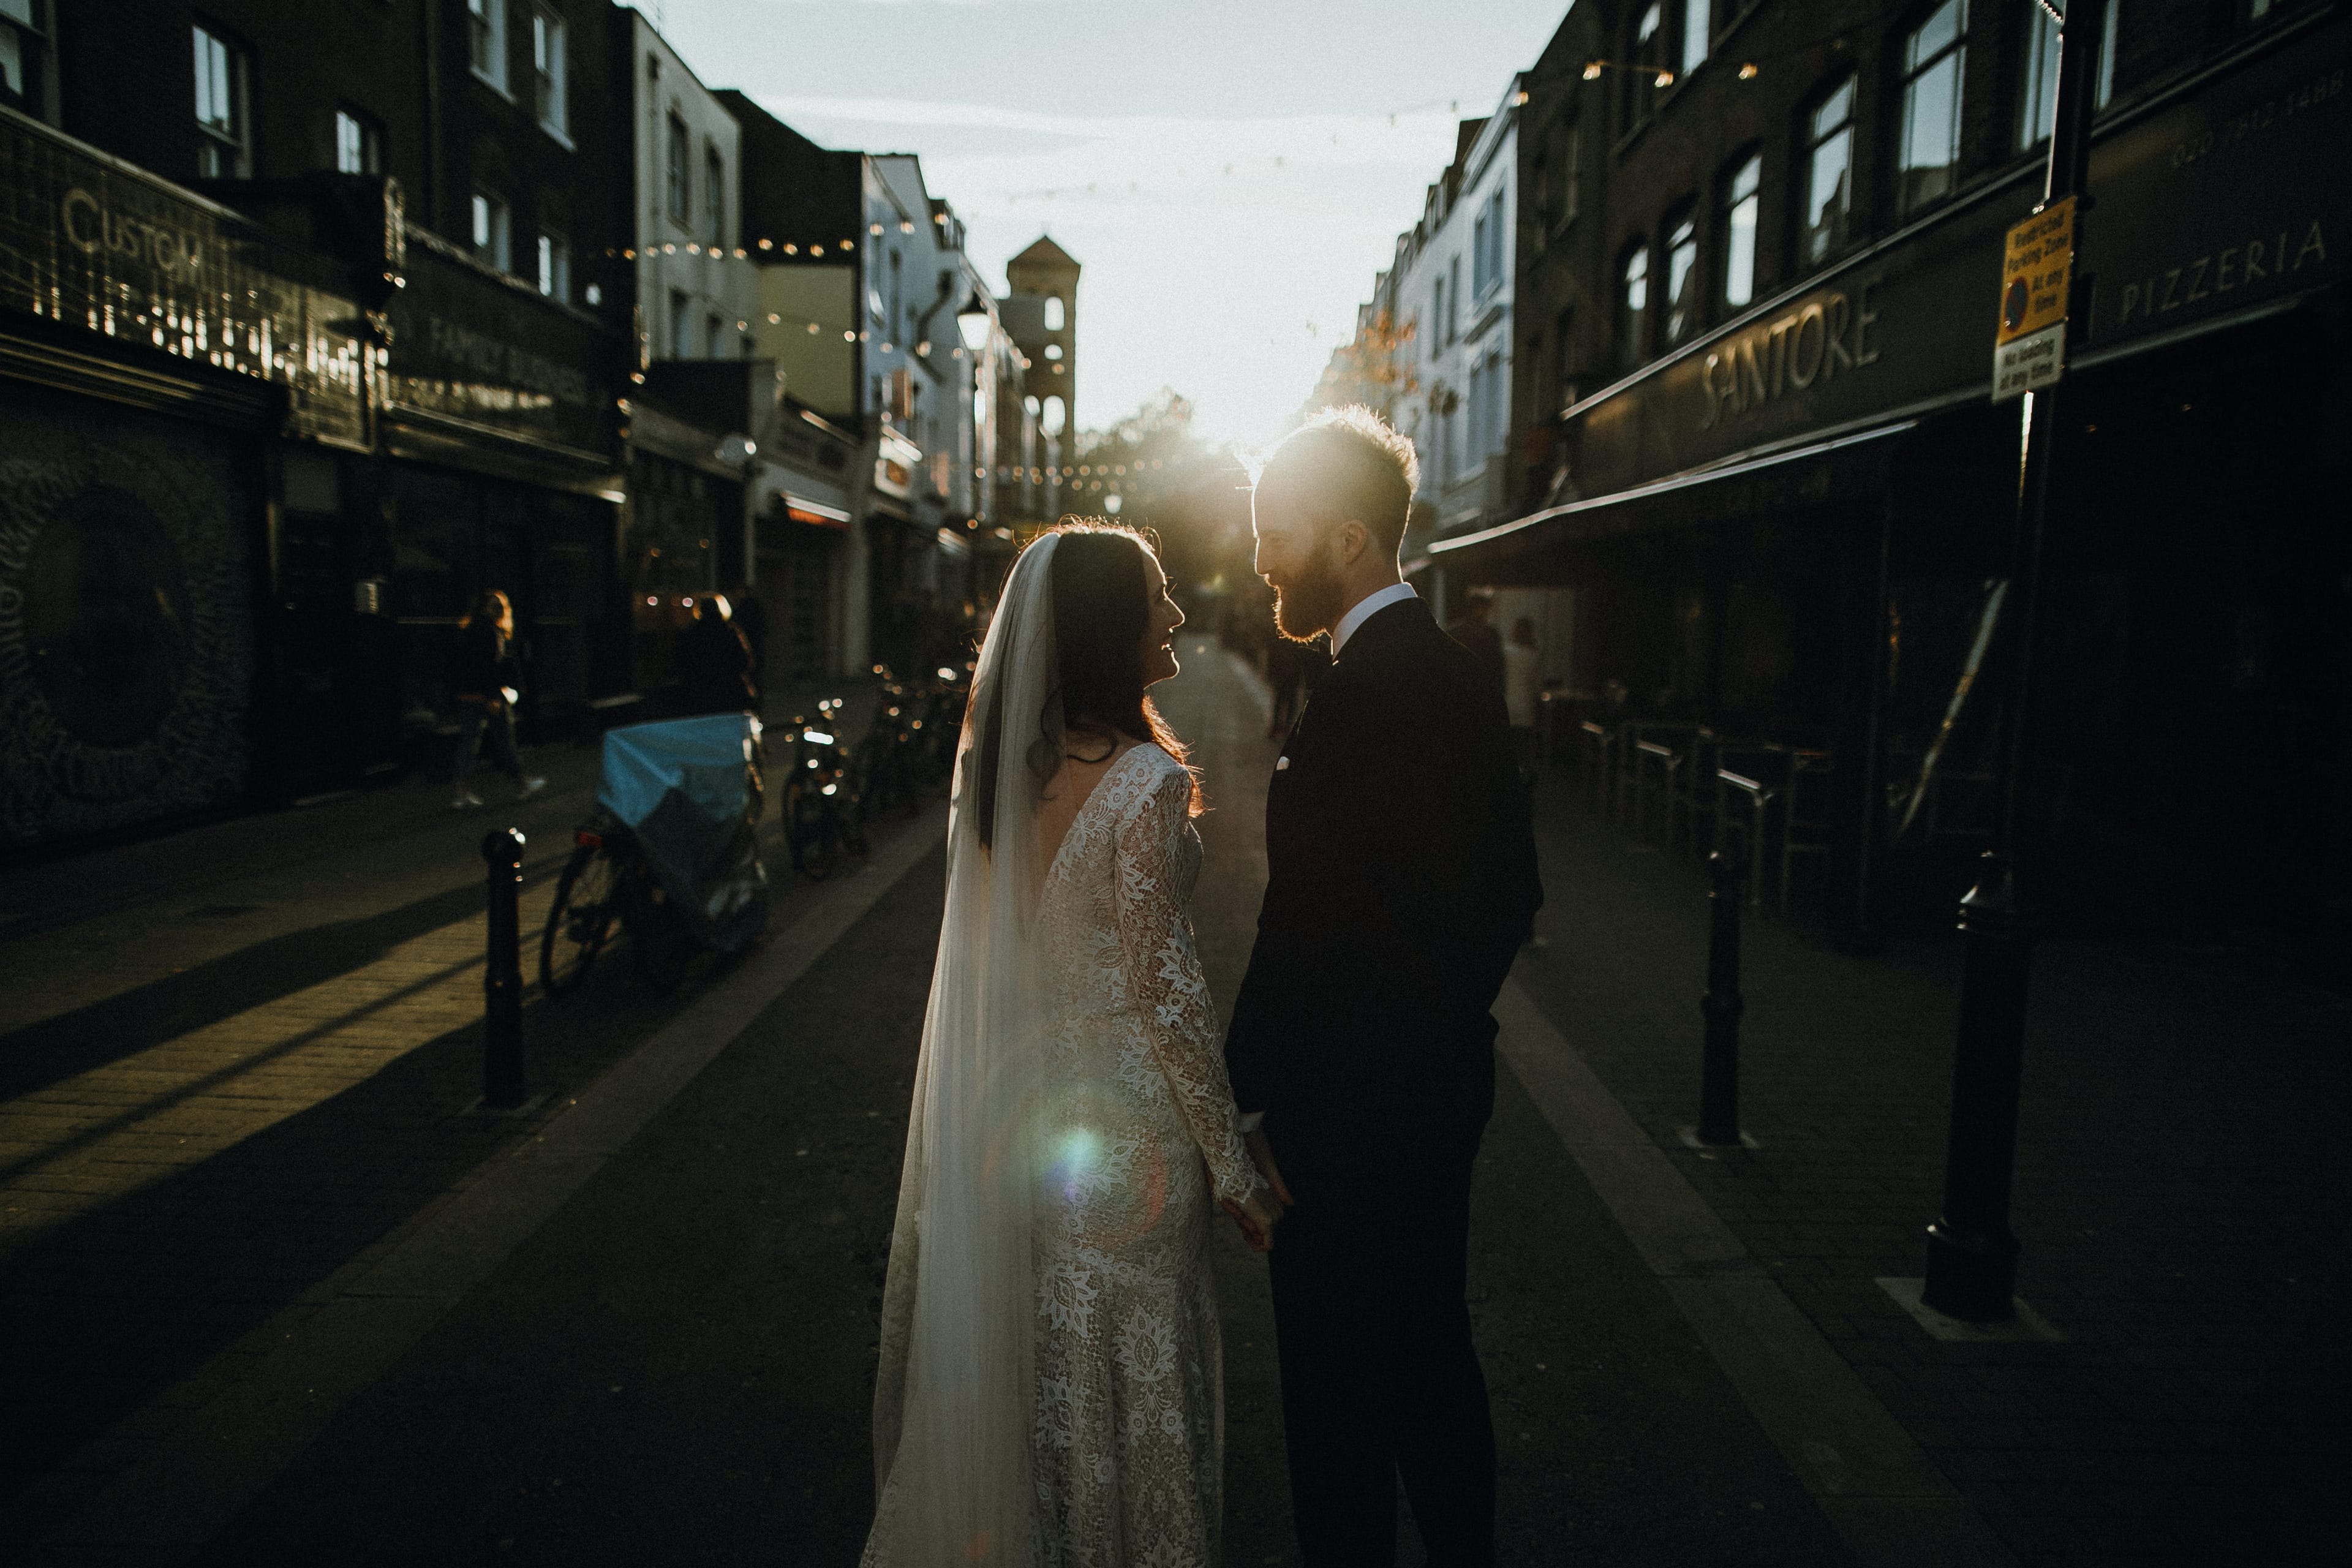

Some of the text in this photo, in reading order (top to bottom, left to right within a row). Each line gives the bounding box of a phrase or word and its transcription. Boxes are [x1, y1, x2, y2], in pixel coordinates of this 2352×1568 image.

[2007, 233, 2069, 274] Parking Zone
[2120, 218, 2326, 324] PIZZERIA
[1700, 279, 1882, 432] SANTORE
